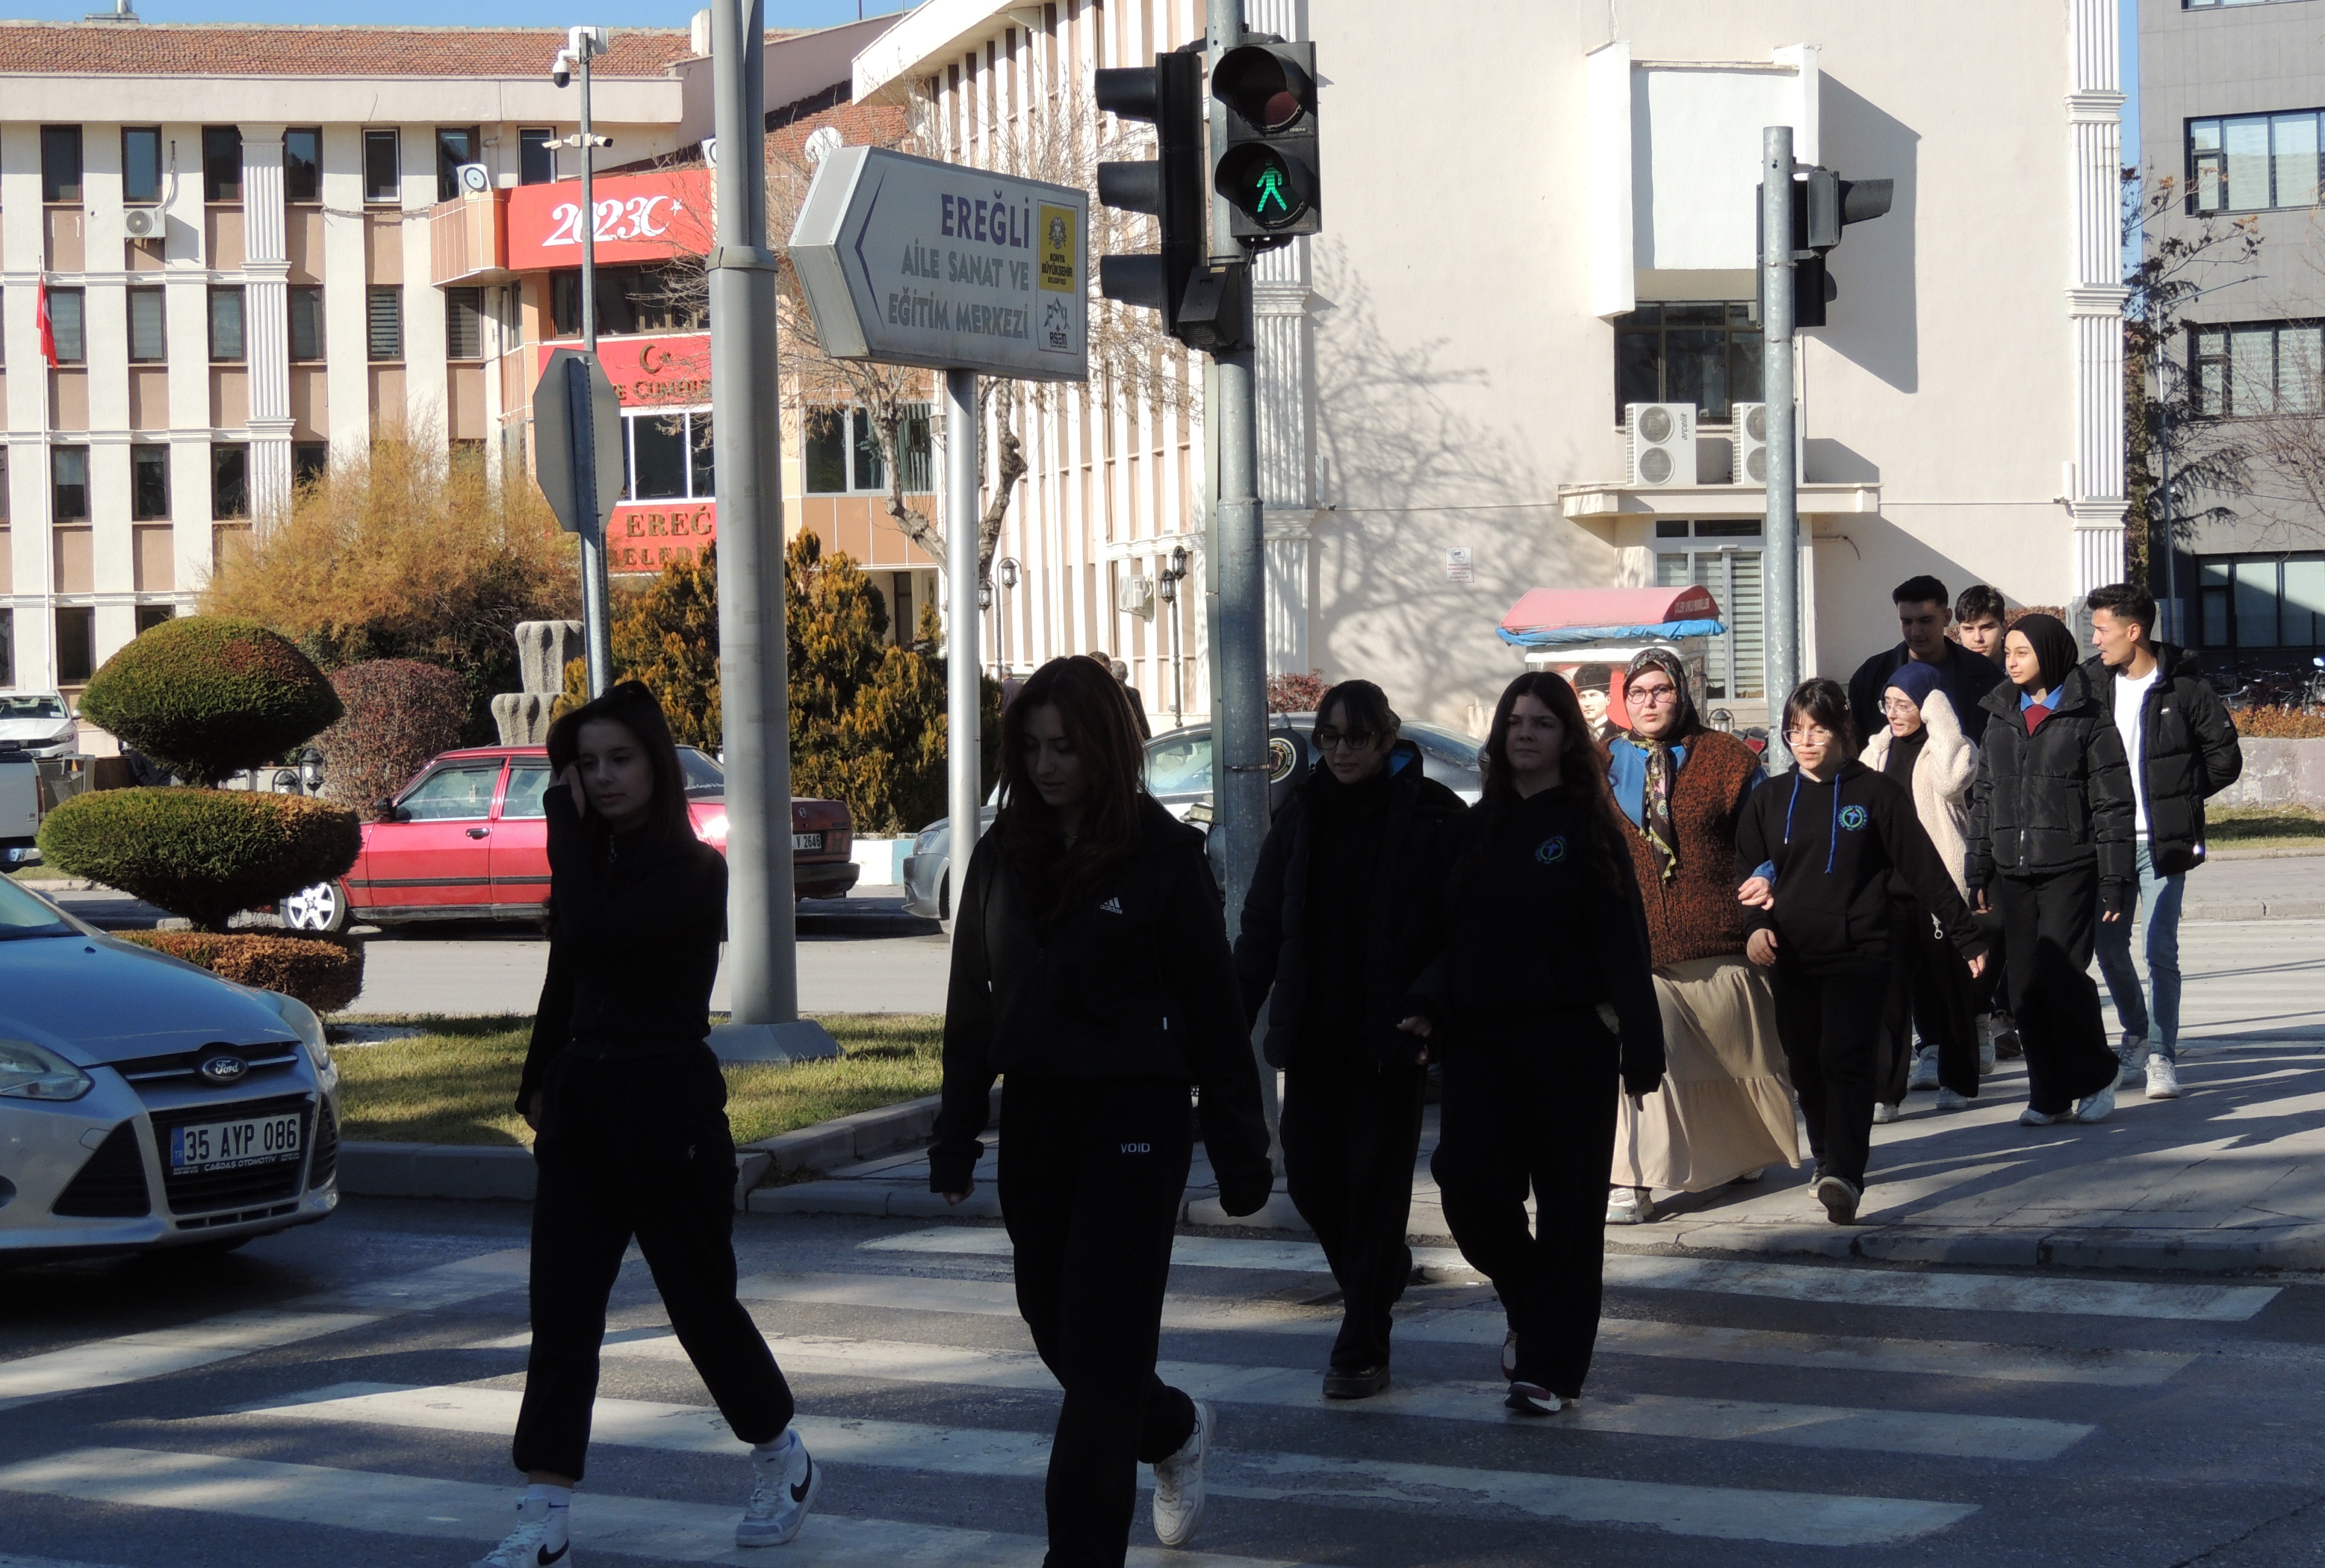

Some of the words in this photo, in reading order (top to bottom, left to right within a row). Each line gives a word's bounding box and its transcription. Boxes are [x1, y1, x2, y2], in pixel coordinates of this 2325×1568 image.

[941, 189, 1029, 249] EREĞLİ
[901, 238, 940, 279] AİLE
[948, 250, 1003, 288] SANAT
[1009, 260, 1029, 291] VE
[1049, 253, 1065, 263] KONYA
[1041, 261, 1073, 278] BÜYÜKŞEHİR
[888, 286, 950, 330] EĞİTİM
[956, 303, 1029, 340] MERKEZİ
[1049, 332, 1068, 345] ASEM
[1680, 412, 1689, 441] arçelik
[626, 505, 712, 537] EREĞ
[803, 835, 820, 848] 2646
[1100, 904, 1123, 915] adidas
[215, 1059, 239, 1075] Ford
[174, 1151, 183, 1159] TR
[186, 1129, 209, 1161] 35
[221, 1124, 254, 1157] AYP
[264, 1118, 296, 1152] 086
[1121, 1143, 1150, 1154] VOID
